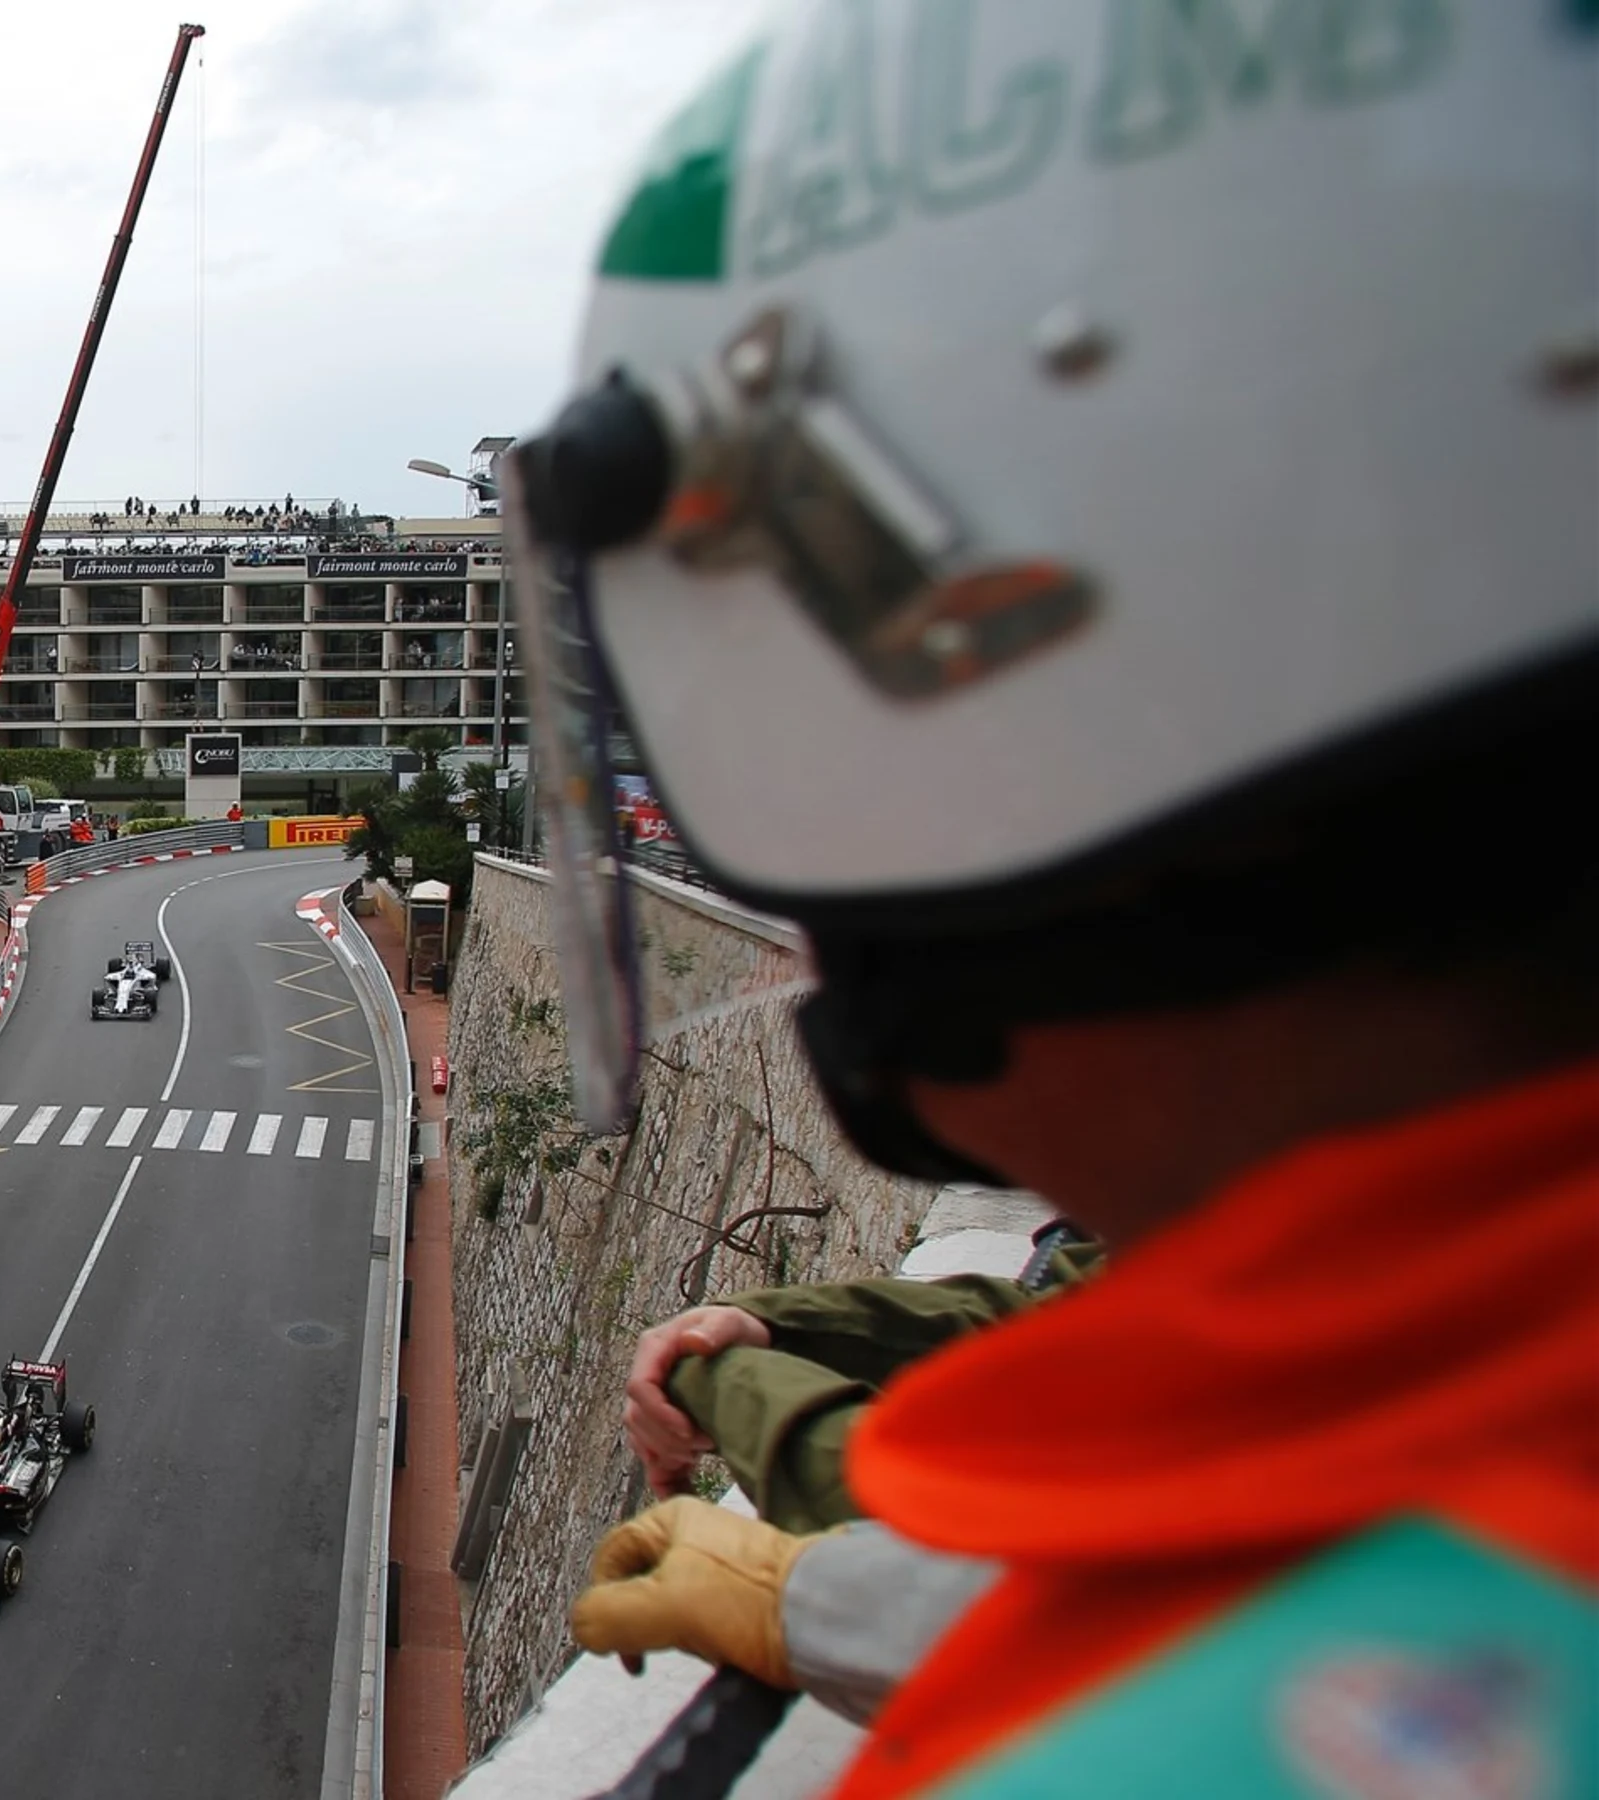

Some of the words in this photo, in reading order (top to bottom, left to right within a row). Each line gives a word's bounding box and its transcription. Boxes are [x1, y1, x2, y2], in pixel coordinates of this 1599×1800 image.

[71, 560, 133, 578] fairmont
[136, 561, 178, 574] monte
[181, 559, 215, 574] carlo
[315, 557, 376, 576] fairmont
[379, 559, 421, 572] monte
[424, 557, 457, 572] carlo
